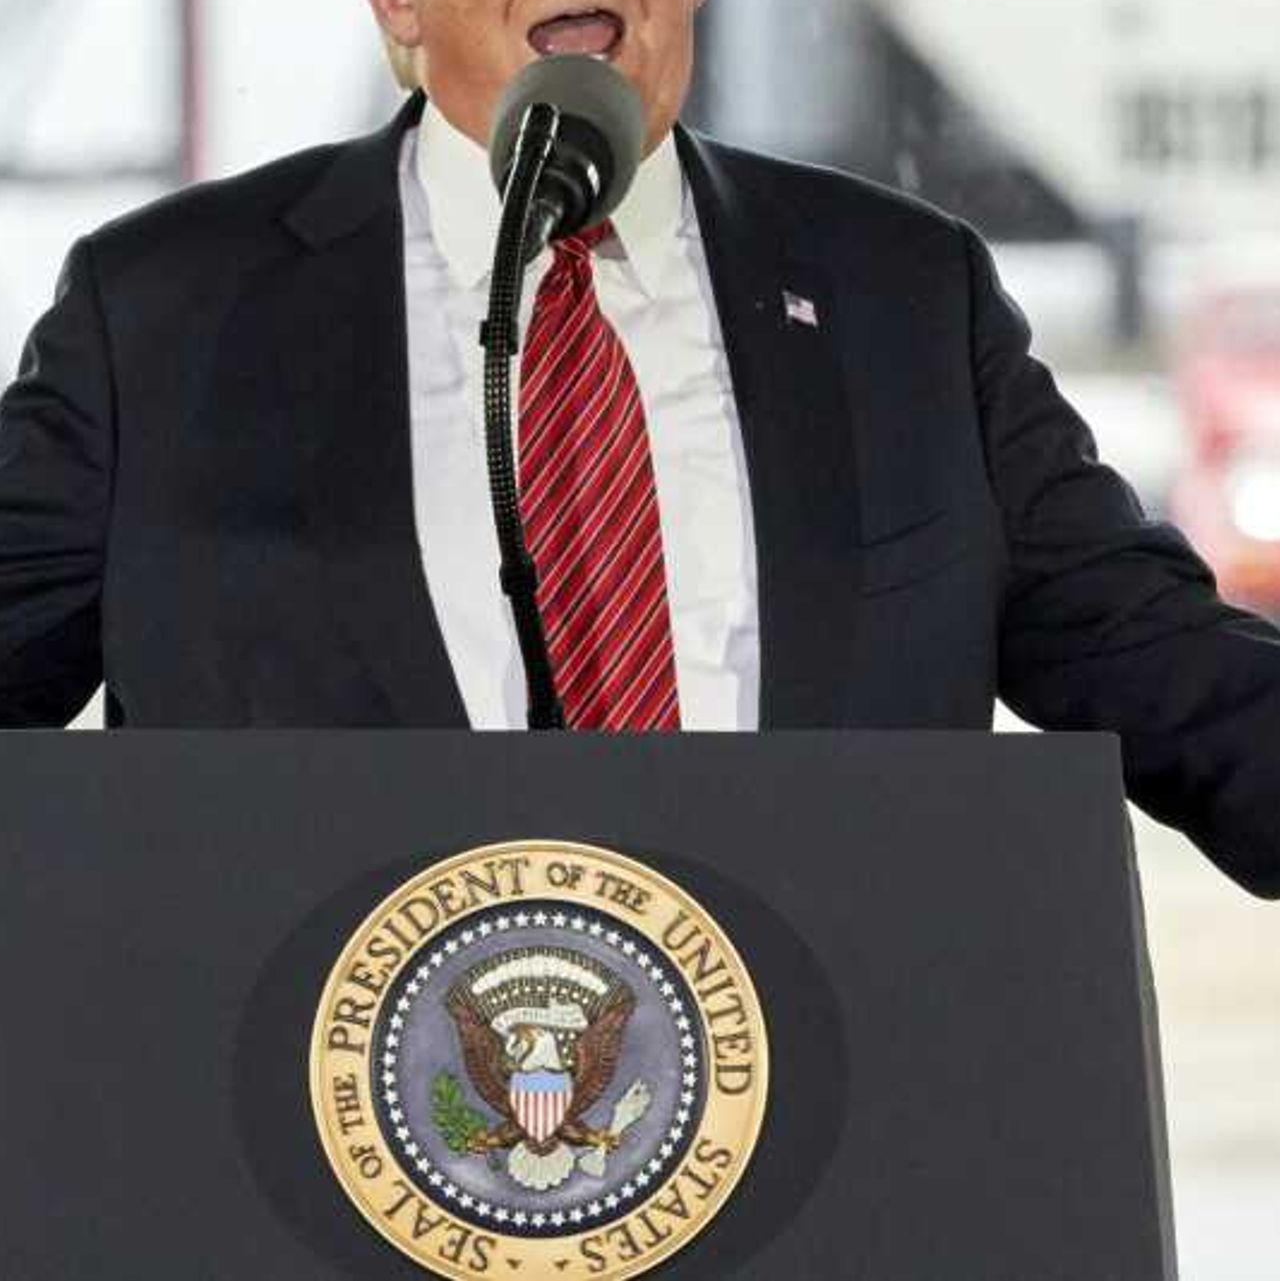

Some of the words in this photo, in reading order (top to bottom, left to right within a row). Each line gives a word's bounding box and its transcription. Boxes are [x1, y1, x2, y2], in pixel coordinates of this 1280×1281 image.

[546, 862, 584, 890] OF
[594, 871, 651, 915] THE
[328, 857, 530, 1057] PRESIDENT
[662, 908, 752, 1095] UNITED
[333, 1073, 365, 1135] THE
[350, 1143, 382, 1179] OF
[384, 1178, 497, 1272] SEAL
[580, 1138, 732, 1272] STATES
